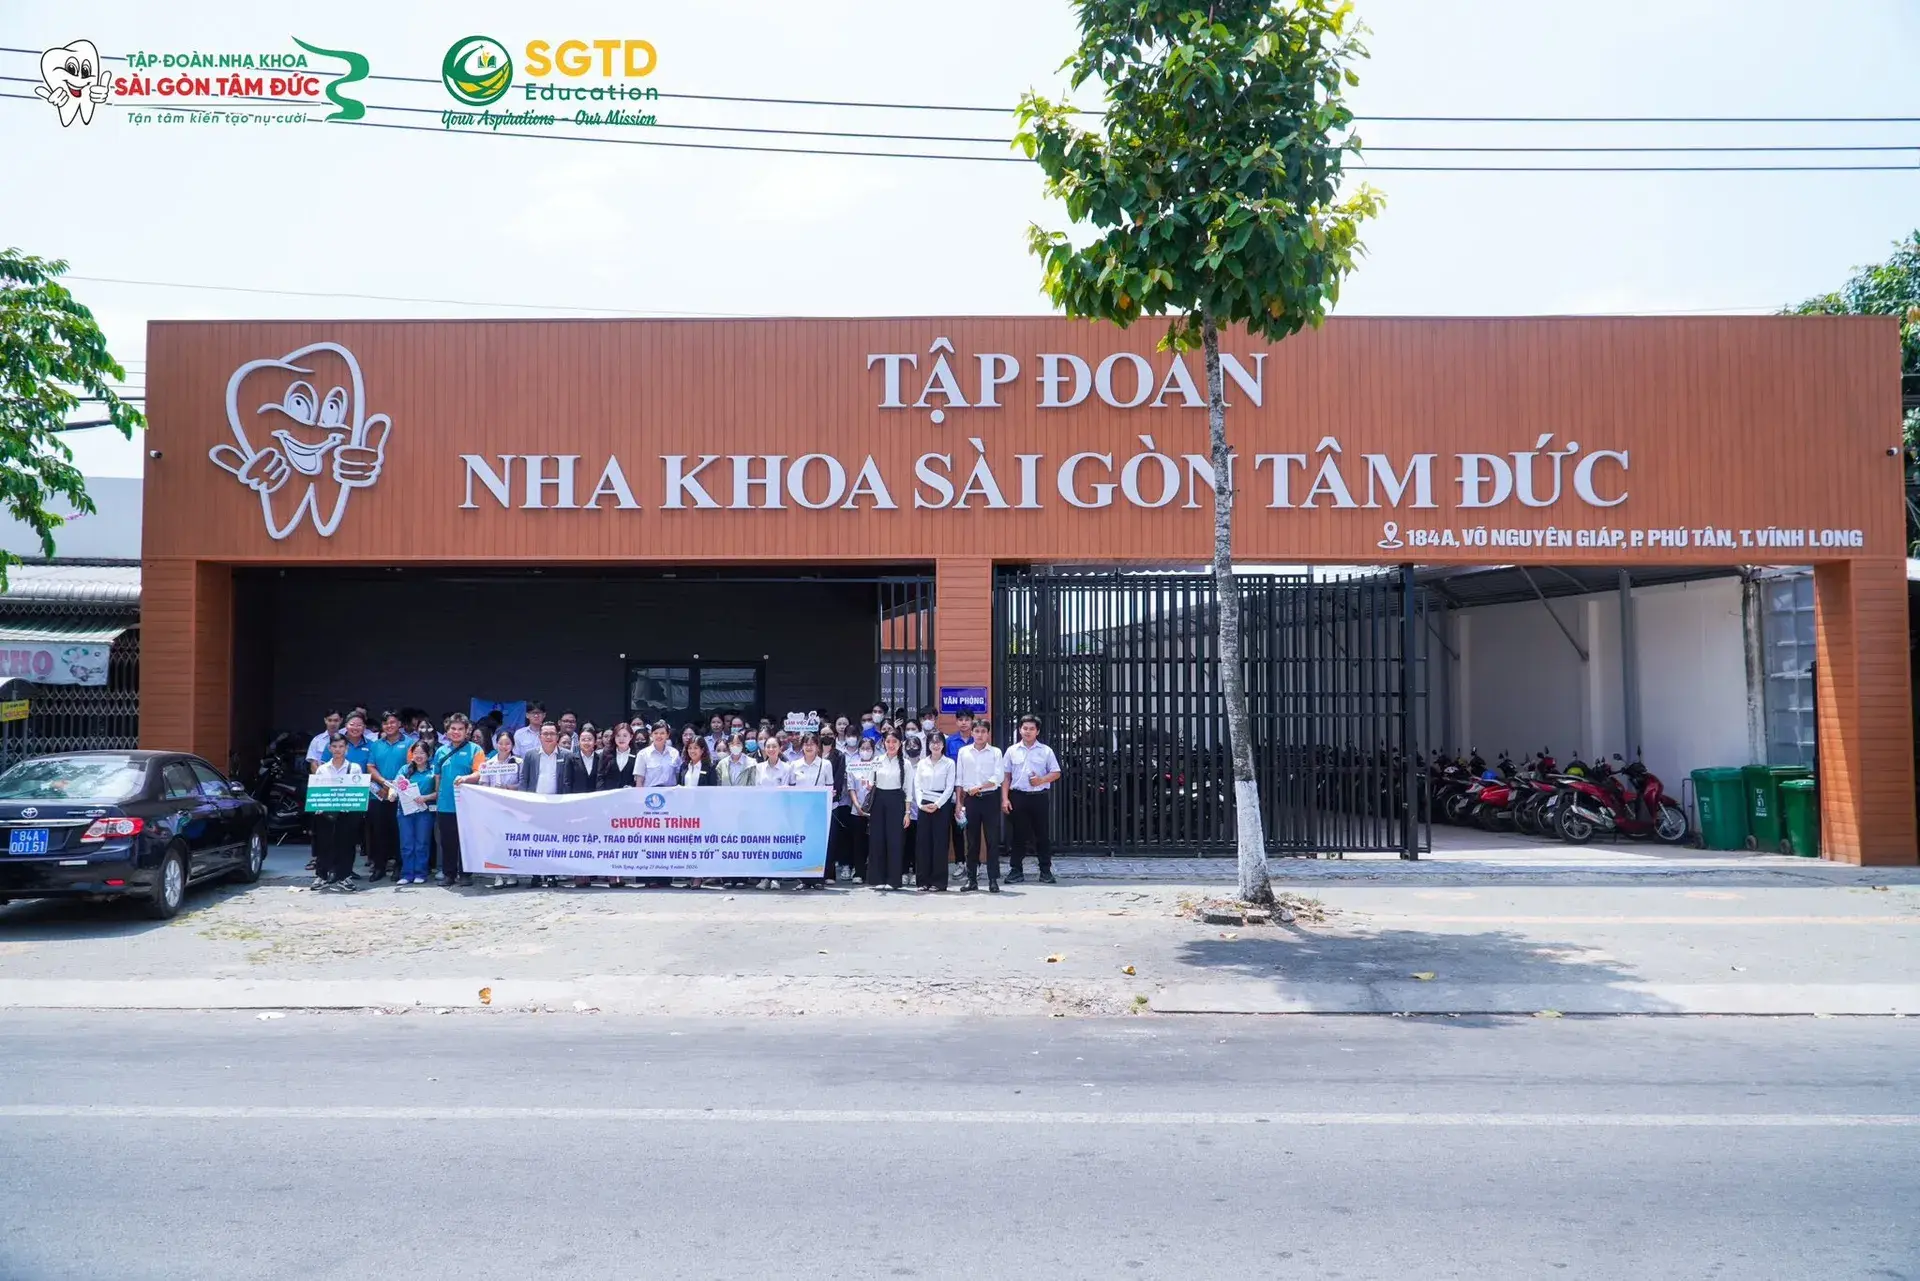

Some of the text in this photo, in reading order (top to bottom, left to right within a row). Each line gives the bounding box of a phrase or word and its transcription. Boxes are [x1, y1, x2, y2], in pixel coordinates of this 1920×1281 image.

[867, 336, 1020, 424] TẬP
[458, 433, 1629, 510] NHA KHOA SÀI GÒN TÂM ĐỨC
[1406, 528, 1460, 549] 184A,
[1462, 525, 1488, 547] VÕ
[1491, 525, 1572, 548] NGUYÊN
[1576, 525, 1627, 549] GIÁP,
[1648, 525, 1688, 548] PHÚ
[1692, 525, 1737, 549] TÂN,
[1756, 525, 1805, 548] VĨNH
[1809, 529, 1863, 548] LONG
[942, 695, 984, 705] VĂN PHÒNG
[611, 815, 700, 829] CHƯƠNG TRÌNH
[19, 830, 39, 841] 84A
[505, 832, 806, 845] THAM QUAN, HỌC TẬP, TRAO ĐỔI KINH NGHIỆM VỚI CÁC DOANH NGHIỆP
[508, 848, 521, 858] TẠI
[523, 847, 544, 858] TỈNH
[546, 847, 567, 858] VĨNH
[569, 850, 595, 859] LONG,
[597, 849, 619, 859] PHÁT
[622, 850, 639, 859] HUY
[669, 850, 689, 860] VIÊN
[691, 850, 697, 860] 5
[722, 850, 740, 860] SAU
[742, 849, 769, 860] TUYÊN
[772, 850, 802, 860] DƯƠNG
